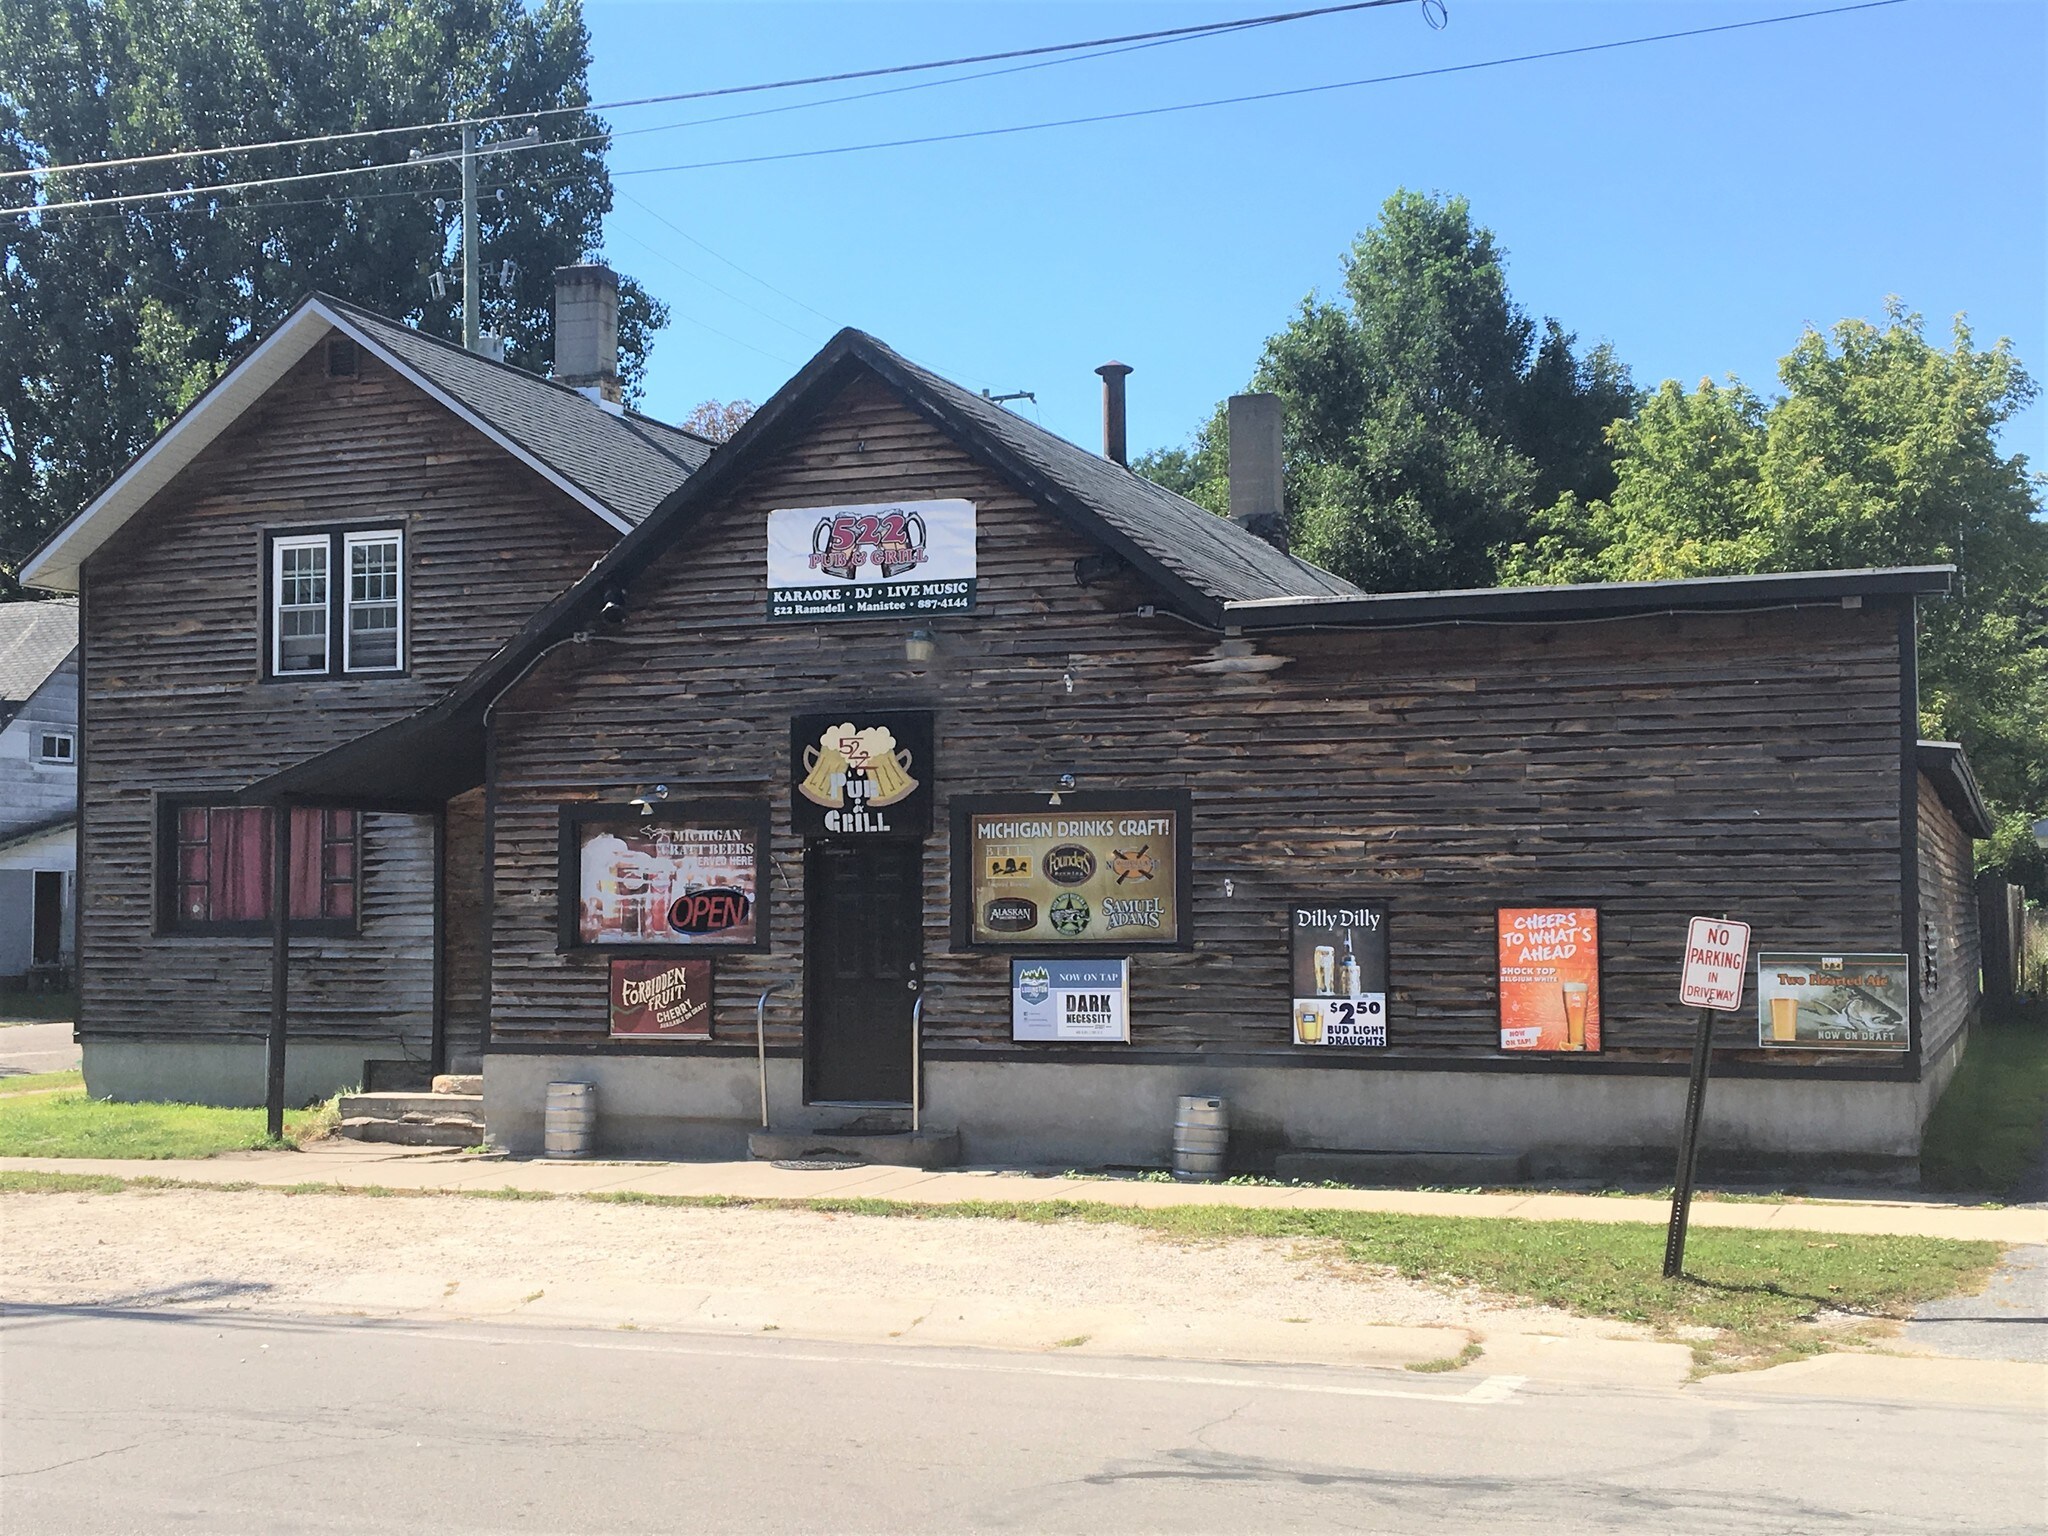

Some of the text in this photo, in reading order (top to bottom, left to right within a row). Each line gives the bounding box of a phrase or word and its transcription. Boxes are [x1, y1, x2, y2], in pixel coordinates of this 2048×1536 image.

[831, 514, 908, 550] 522
[809, 547, 929, 569] PUB & GRILL
[773, 582, 968, 602] KARAOKE DJ LIVE MUSIC
[774, 598, 968, 616] 522 Ramsdell Manistee 887-4144
[839, 737, 879, 770] 522
[824, 809, 891, 833] GRILL
[978, 818, 1170, 839] MICHIGAN DRINKS CRAFT!
[673, 828, 742, 842] MICHIGAN
[708, 842, 755, 855] BEERS
[729, 855, 754, 866] HERE
[1050, 851, 1091, 874] Founders
[671, 895, 746, 928] OPEN
[990, 907, 1031, 921] ALASKAN
[1102, 897, 1166, 916] SAMUEL
[1106, 911, 1161, 930] ADAMS
[1297, 909, 1381, 931] Dilly Dilly
[1514, 912, 1577, 930] CHEERS
[1502, 926, 1592, 947] TO WHAT'S
[1707, 928, 1730, 946] NO
[1519, 944, 1577, 963] AHEAD
[1690, 947, 1742, 970] PARKING
[1060, 972, 1119, 982] NOW ON TAP
[1501, 967, 1556, 975] SHOCK TOP
[1707, 971, 1719, 983] IN
[1777, 973, 1806, 986] Two
[622, 967, 686, 1006] FORBIDDEN
[1686, 985, 1735, 1002] DRIVEWAY
[648, 984, 687, 1011] FRUIT
[1066, 994, 1111, 1012] DARK
[656, 998, 692, 1023] CHERRY
[1066, 1014, 1112, 1024] NECESSITY
[1327, 1025, 1385, 1035] BUD LIGHT
[1818, 1030, 1895, 1042] NOW ON DRAFT
[1328, 1036, 1385, 1046] DRAUGHTS
